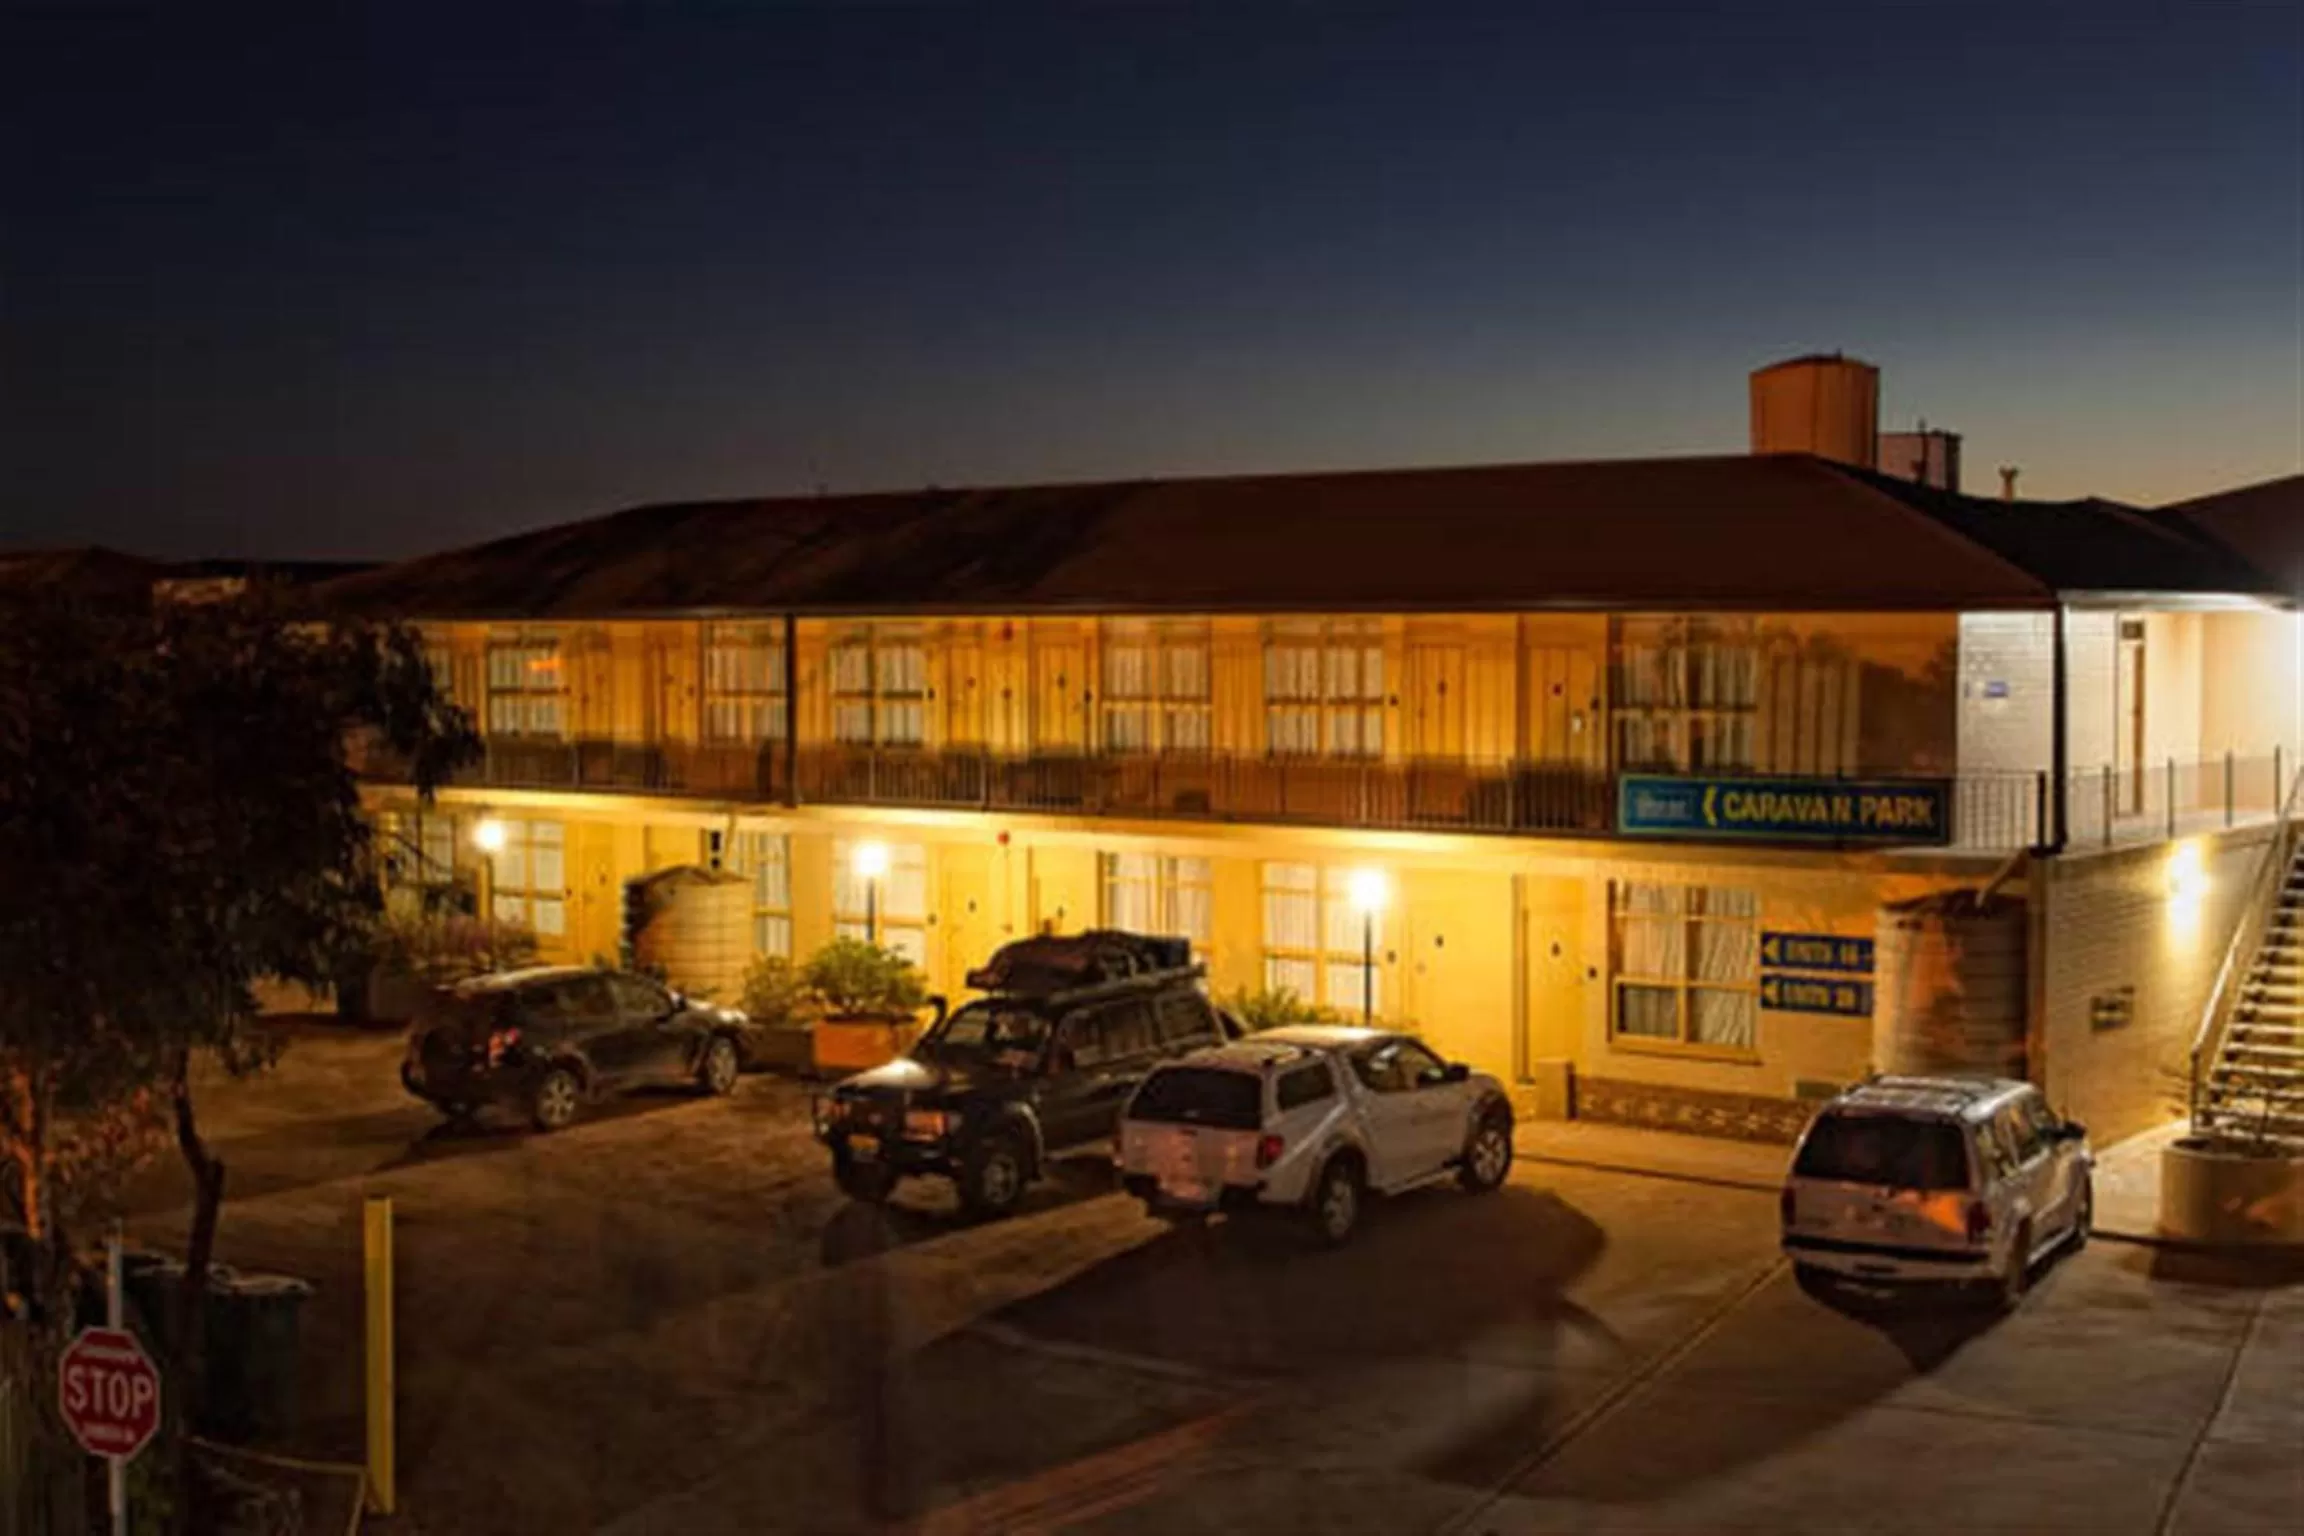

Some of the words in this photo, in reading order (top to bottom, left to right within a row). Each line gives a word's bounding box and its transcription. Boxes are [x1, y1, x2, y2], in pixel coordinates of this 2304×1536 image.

[1723, 791, 1851, 823] CARAVAN
[1860, 796, 1935, 828] PARK
[66, 1364, 153, 1419] STOP
